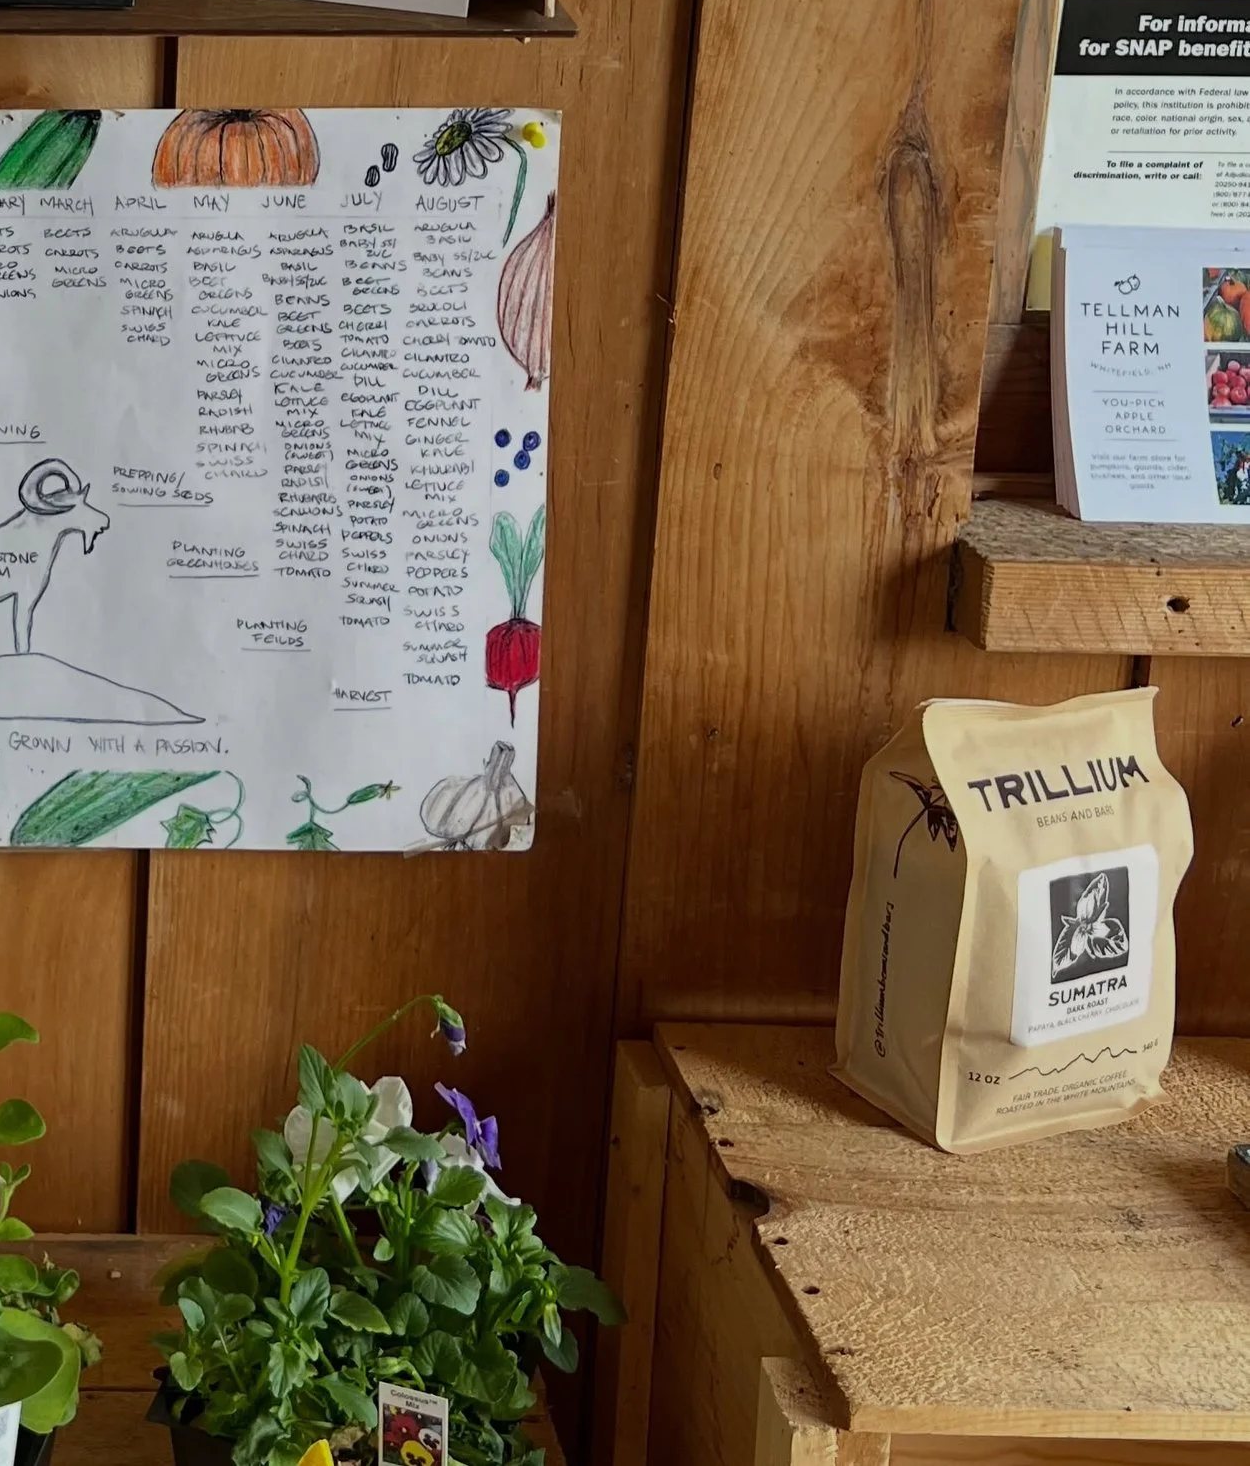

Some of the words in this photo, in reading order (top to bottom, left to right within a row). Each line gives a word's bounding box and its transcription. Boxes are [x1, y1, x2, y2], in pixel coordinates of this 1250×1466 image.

[1139, 16, 1172, 32] For
[1079, 39, 1110, 56] for
[1115, 39, 1173, 56] SNAP
[1126, 88, 1175, 96] accordance
[1178, 88, 1196, 96] with
[1199, 88, 1231, 96] Federal
[1234, 88, 1248, 96] law
[1113, 101, 1139, 109] policy,
[1161, 101, 1203, 109] institution
[1161, 114, 1195, 122] national
[1184, 128, 1203, 136] prior
[1107, 160, 1116, 168] To
[1120, 160, 1134, 168] file
[1146, 161, 1190, 169] complaint
[1074, 172, 1141, 180] discrimination,
[40, 196, 93, 216] MARCH
[115, 196, 167, 210] APRIL
[194, 193, 229, 212] MAY
[262, 195, 306, 209] JUNE
[340, 191, 382, 211] JULY
[416, 195, 484, 212] AUGUST
[114, 261, 168, 272] CARROTS
[193, 262, 236, 272] BASIL
[1081, 302, 1180, 317] TELLMAN
[1106, 322, 1154, 336] HILL
[1102, 341, 1159, 355] FARM
[404, 353, 469, 363] CILANTRO
[418, 386, 458, 398] DILL
[405, 399, 482, 411] EGGPLANT
[1102, 398, 1164, 407] YOU-PICK
[407, 416, 471, 428] FENNEL
[1116, 412, 1153, 420] APPLE
[1105, 425, 1166, 434] ORCHARD
[350, 474, 394, 482] ONIONS
[112, 483, 166, 498] SOWING
[172, 541, 245, 558] PLANTING
[237, 619, 307, 632] PLANTING
[402, 672, 460, 686] TOMATO
[332, 690, 392, 703] HARVEST
[8, 732, 71, 753] GROWN
[90, 735, 125, 754] WITH
[133, 738, 145, 752] A
[967, 755, 1149, 812] TRILLIUM
[1037, 812, 1067, 828] BEANS
[1071, 808, 1093, 821] AND
[1095, 804, 1114, 818] BARS
[1048, 975, 1127, 1007] SUMATRA
[1067, 1005, 1085, 1014] DARK
[1087, 998, 1108, 1009] ROAST
[968, 1072, 981, 1082] 12
[985, 1075, 1000, 1084] OZ
[1013, 1092, 1031, 1102] FAIR
[1033, 1086, 1059, 1098] TRADE
[1062, 1078, 1098, 1092] ORGANIC
[1100, 1070, 1127, 1084] COFFEE
[996, 1102, 1033, 1115] ROASTED
[1035, 1099, 1045, 1107] IN
[1047, 1095, 1061, 1104] THE
[1063, 1090, 1088, 1101] WHITE
[1091, 1078, 1136, 1094] MOUNTAINS
[406, 1401, 420, 1410] Mix
